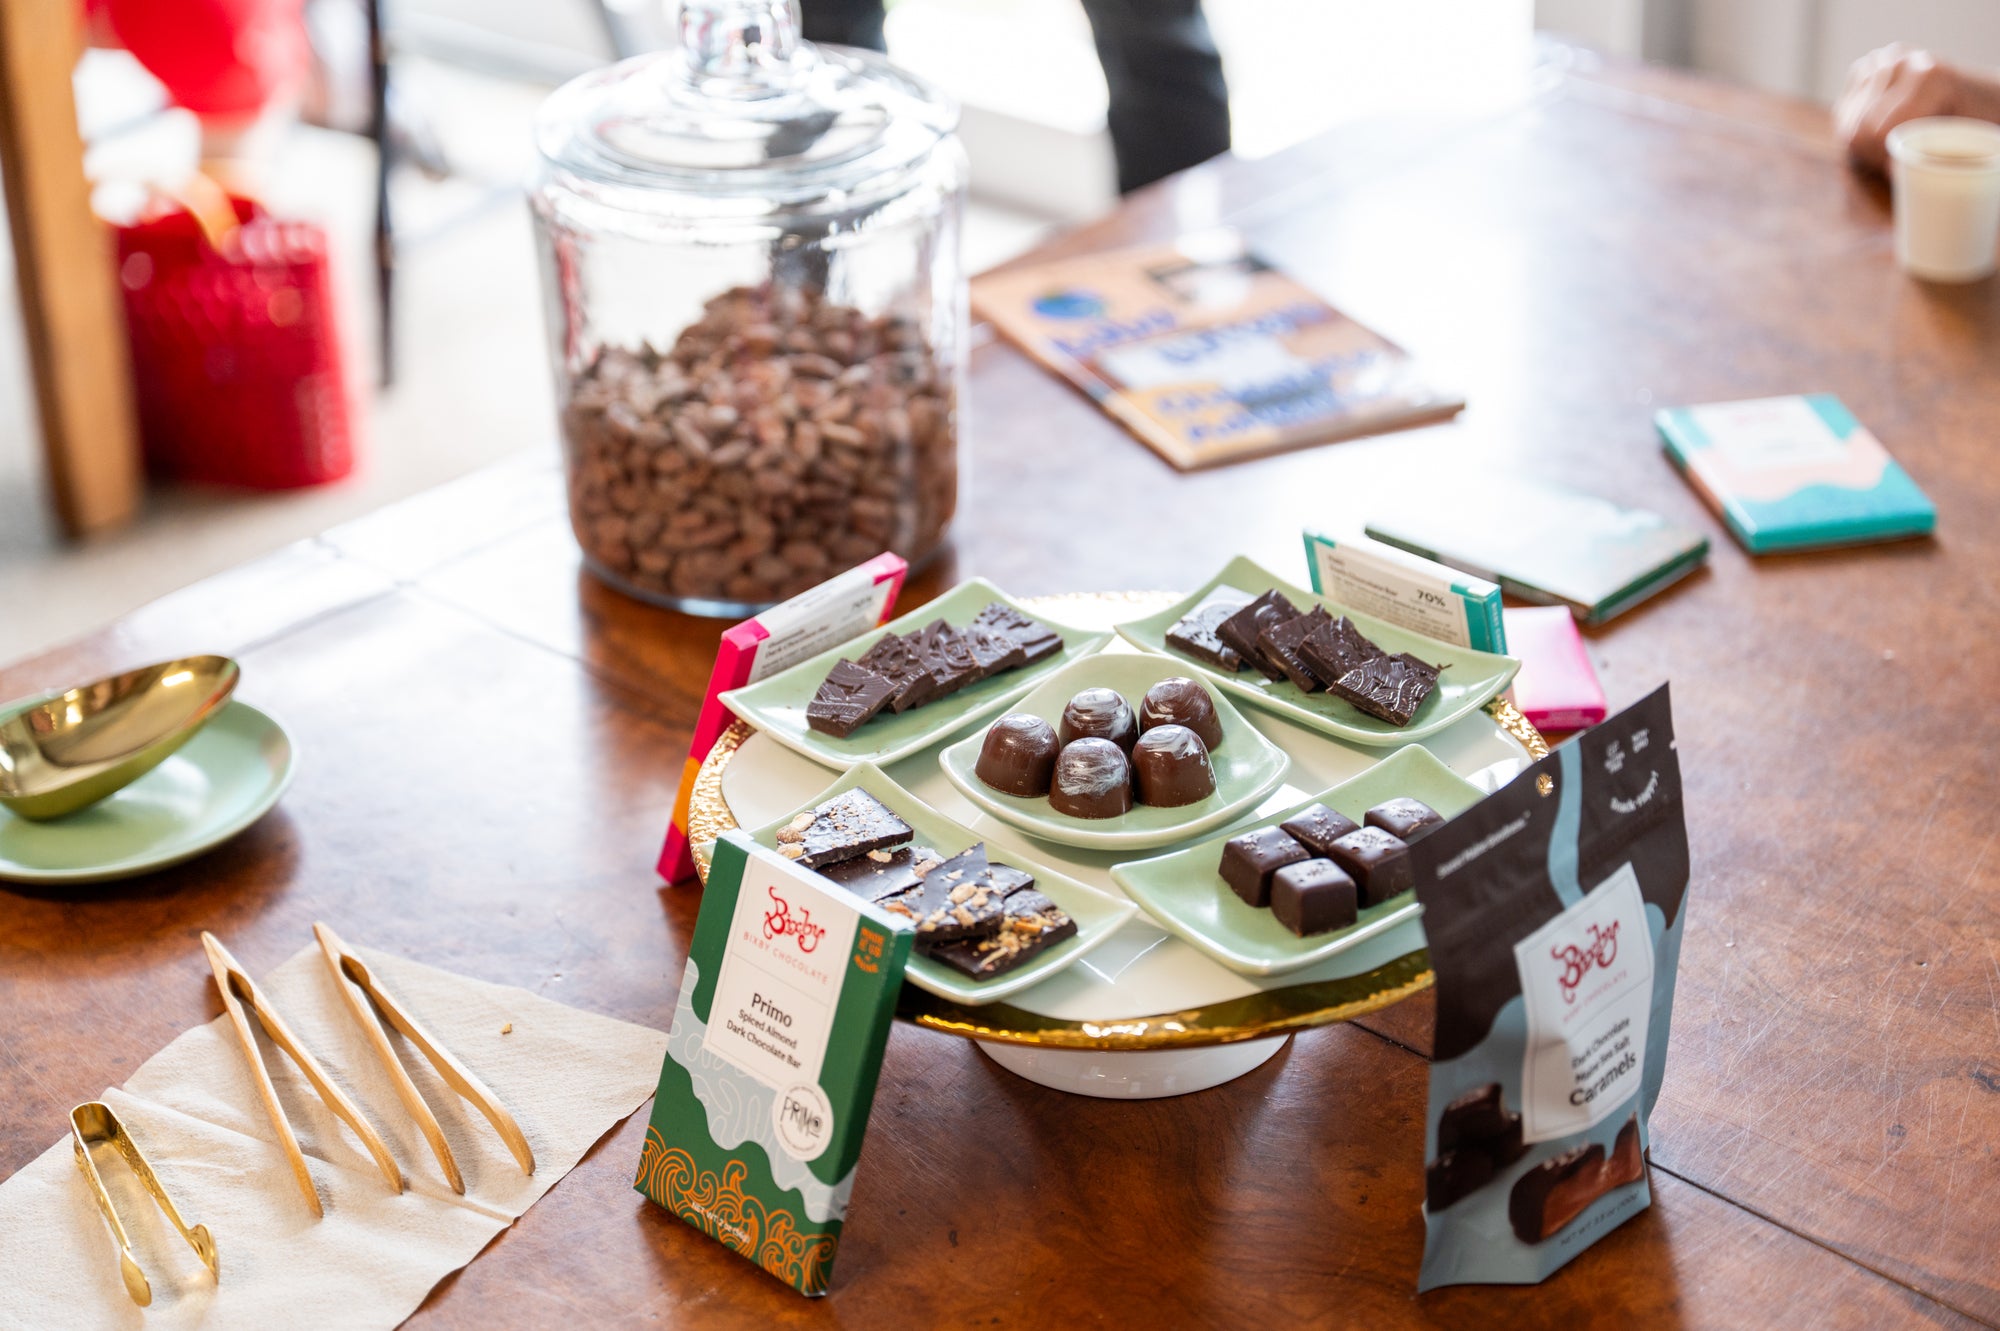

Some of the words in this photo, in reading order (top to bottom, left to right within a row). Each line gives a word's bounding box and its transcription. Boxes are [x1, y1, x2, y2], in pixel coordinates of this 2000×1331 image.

[1417, 588, 1447, 608] 70%
[763, 886, 826, 954] Bixby
[743, 931, 770, 952] BIXBY
[772, 948, 829, 985] CHOCOLATE
[1551, 920, 1619, 1005] Bixby
[738, 1009, 765, 1031] Spiced
[766, 1025, 798, 1049] Almond
[751, 992, 793, 1028] Primo
[726, 1019, 746, 1038] Dark
[746, 1031, 786, 1060] Chocolate
[786, 1054, 802, 1069] Bar
[1569, 1051, 1636, 1107] Caramels
